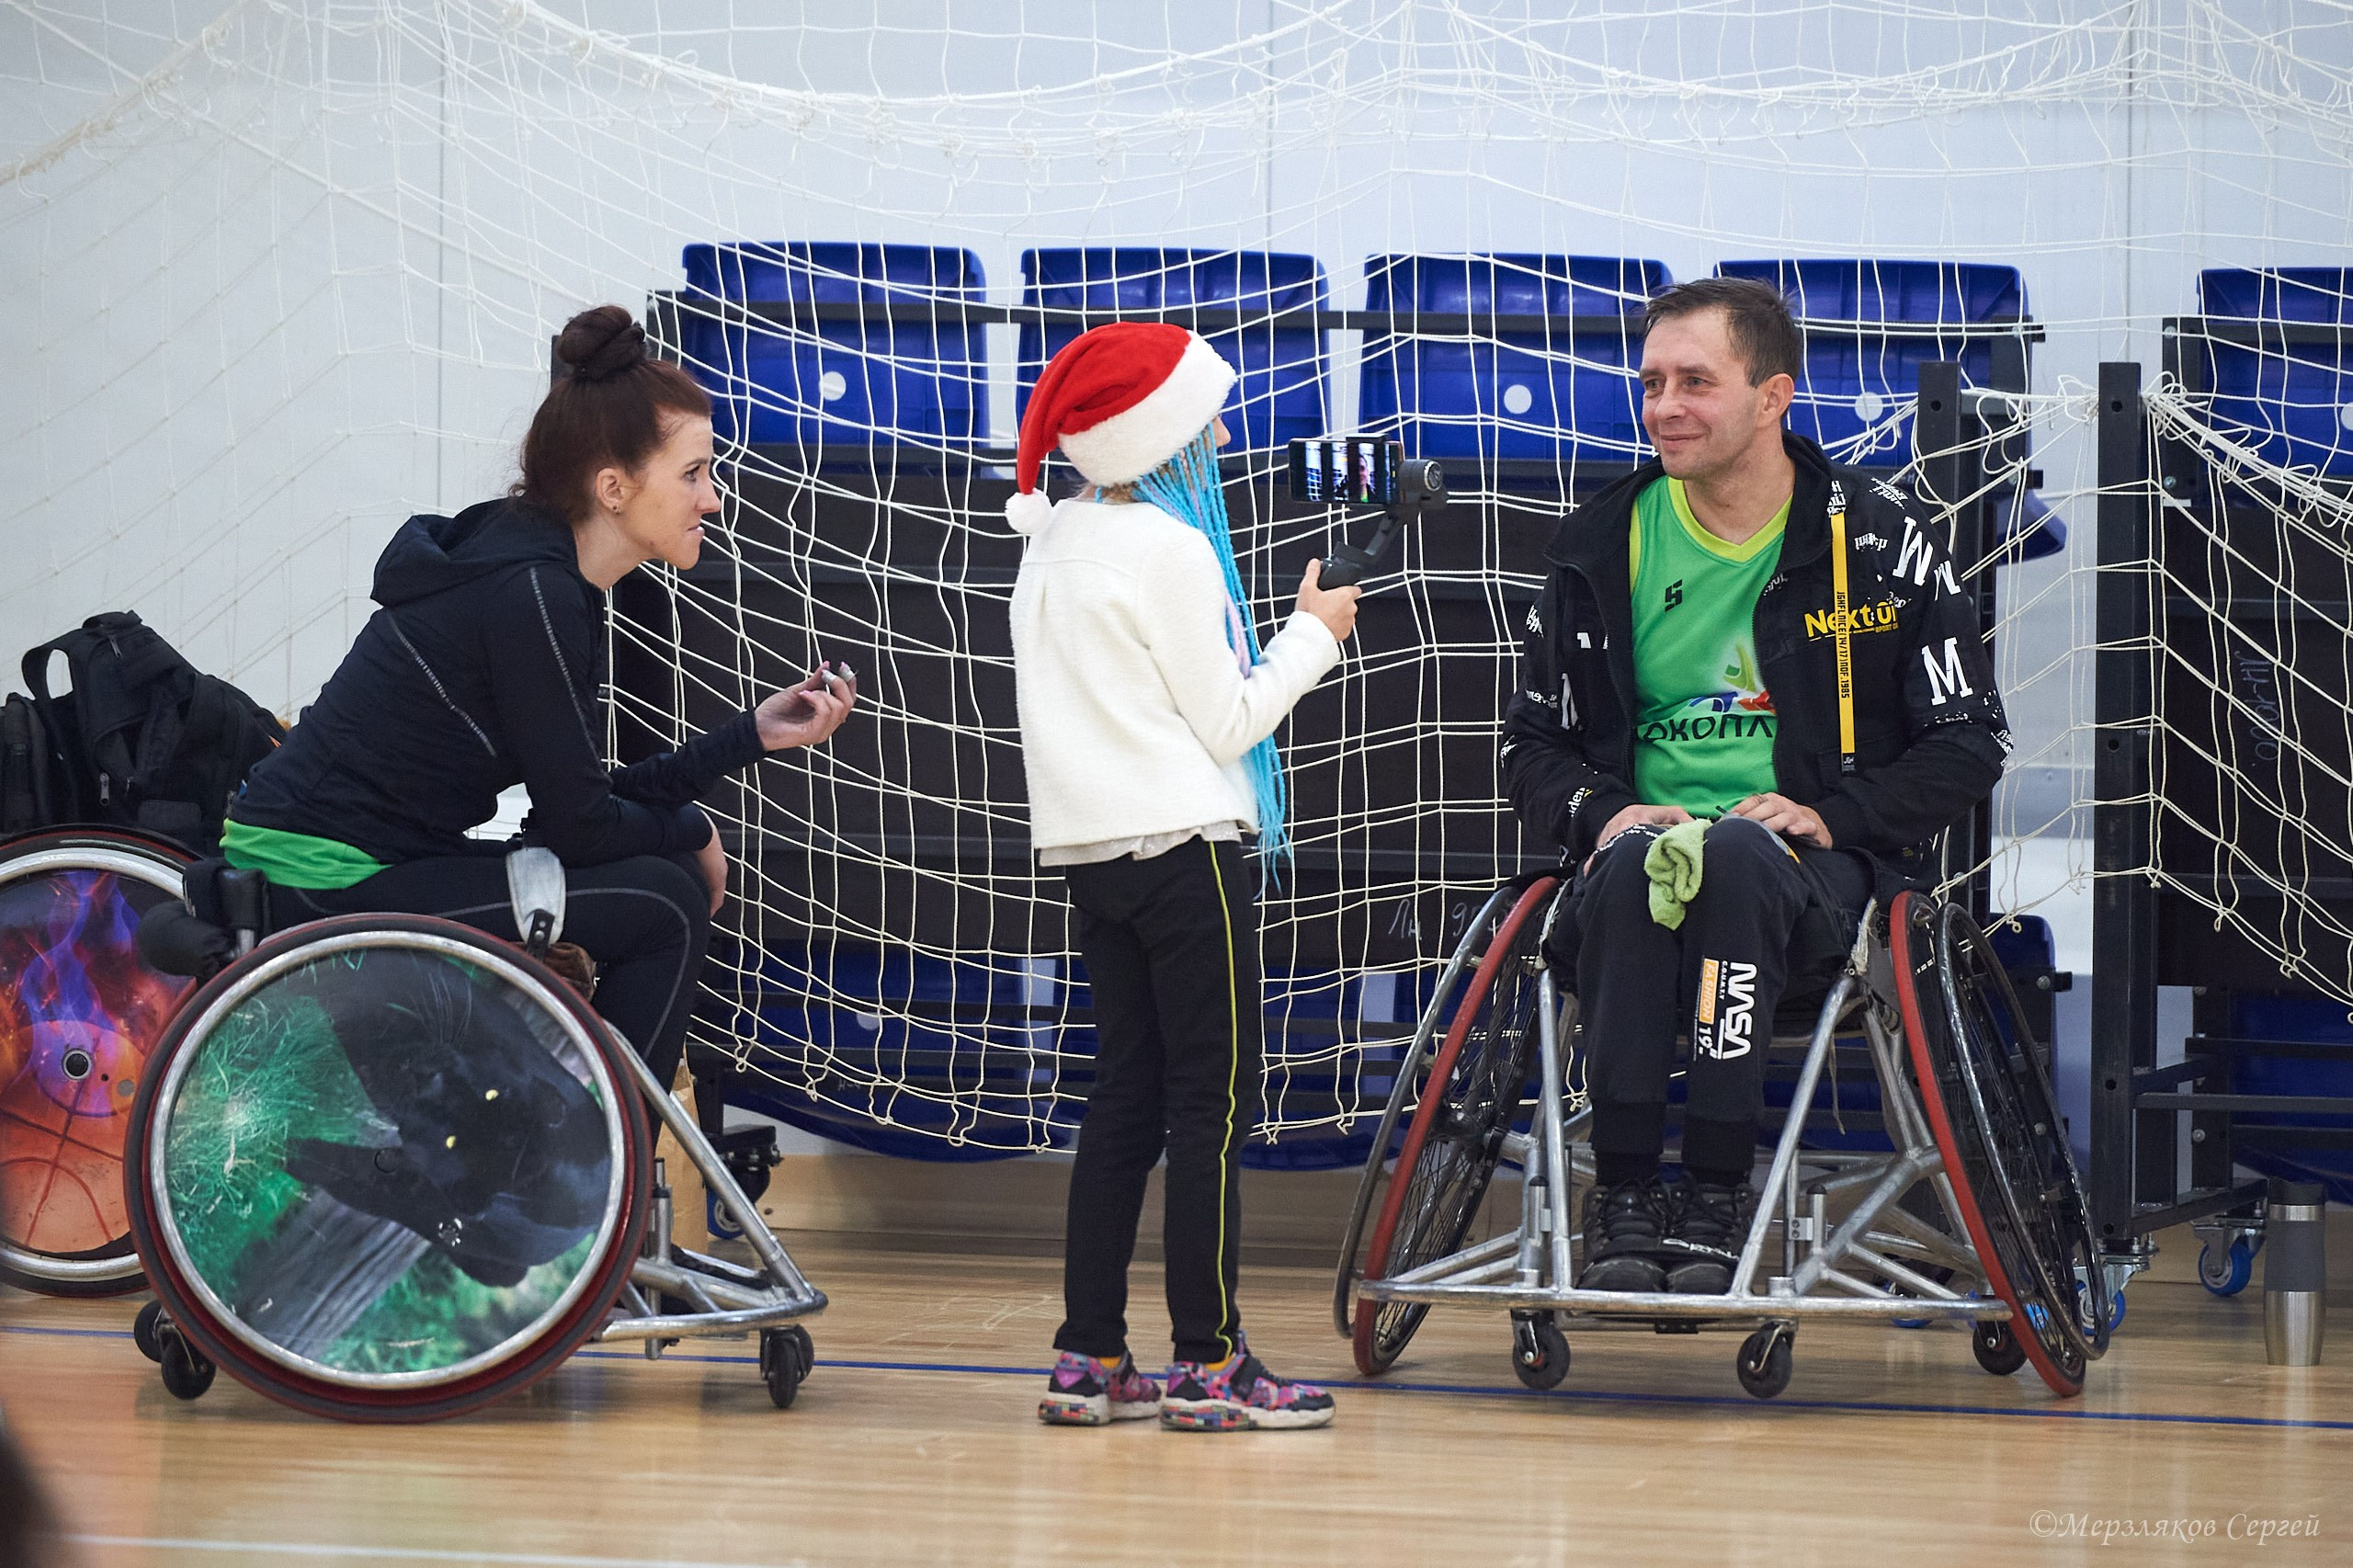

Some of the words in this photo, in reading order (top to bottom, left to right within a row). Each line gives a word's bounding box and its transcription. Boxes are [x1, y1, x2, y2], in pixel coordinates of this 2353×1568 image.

[1921, 636, 1973, 706] M
[1702, 963, 1715, 1018] FASHION
[1722, 962, 1757, 1059] NASA
